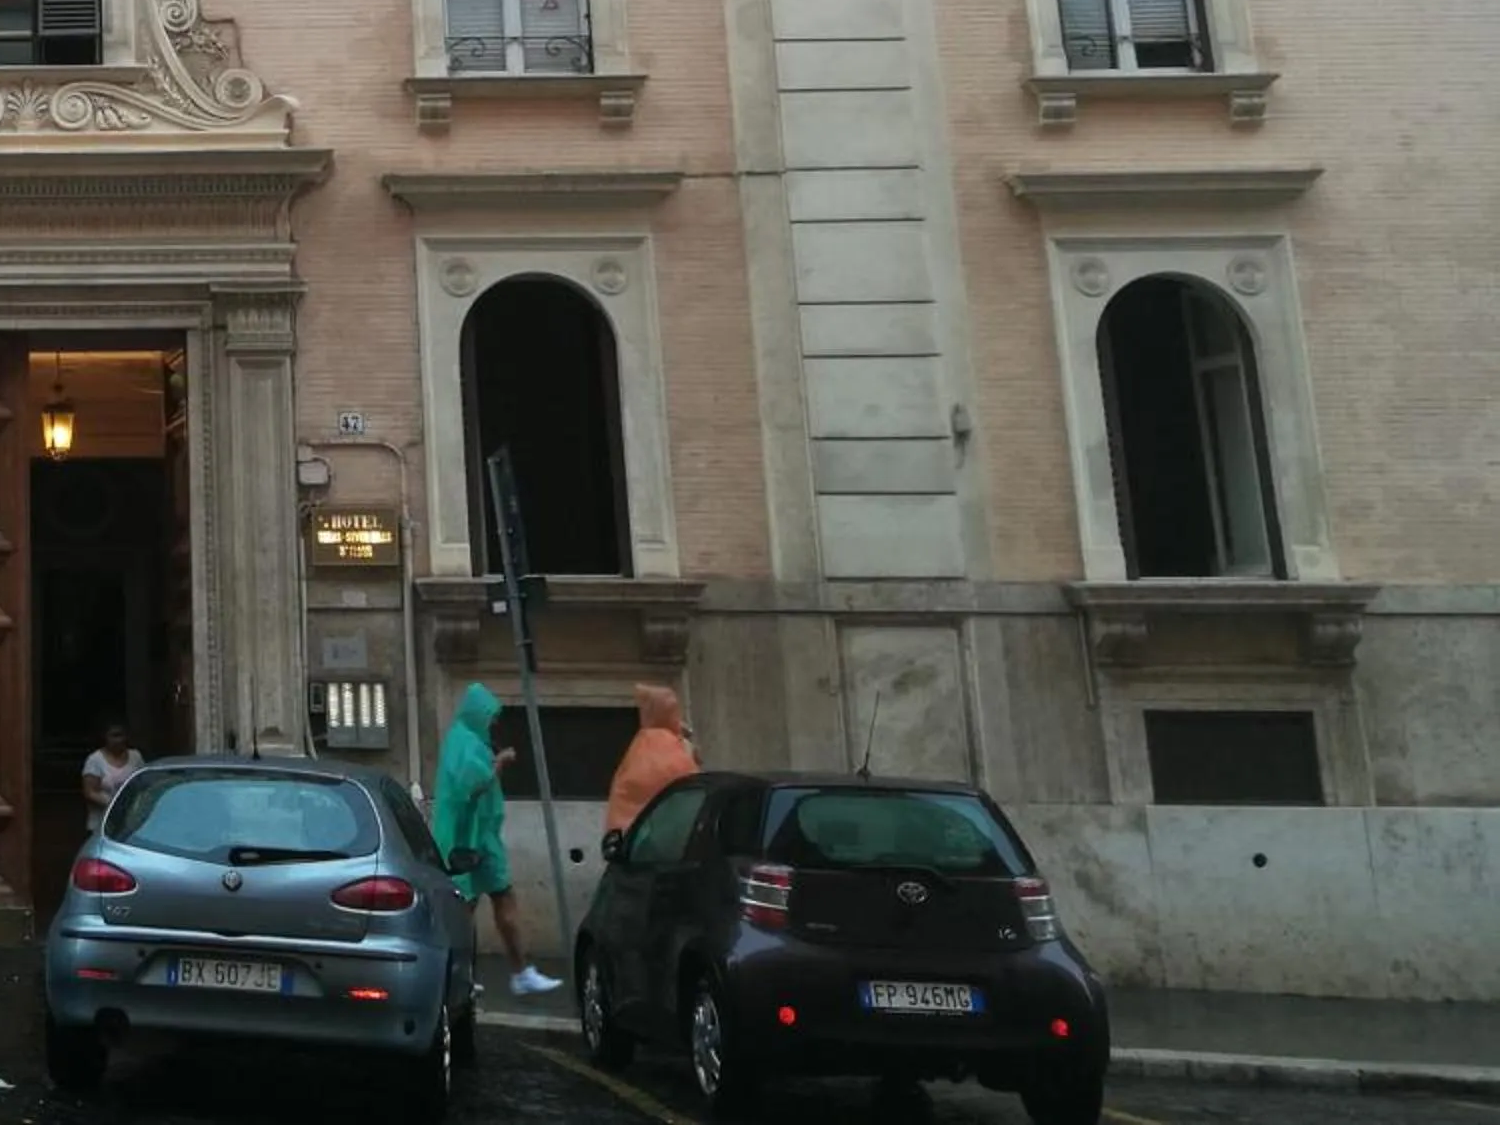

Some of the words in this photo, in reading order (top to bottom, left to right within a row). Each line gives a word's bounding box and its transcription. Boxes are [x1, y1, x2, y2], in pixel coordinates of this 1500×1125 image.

[331, 514, 382, 529] HOTEL
[180, 959, 205, 983] BX
[214, 961, 279, 991] 607JE
[873, 984, 897, 1006] FP
